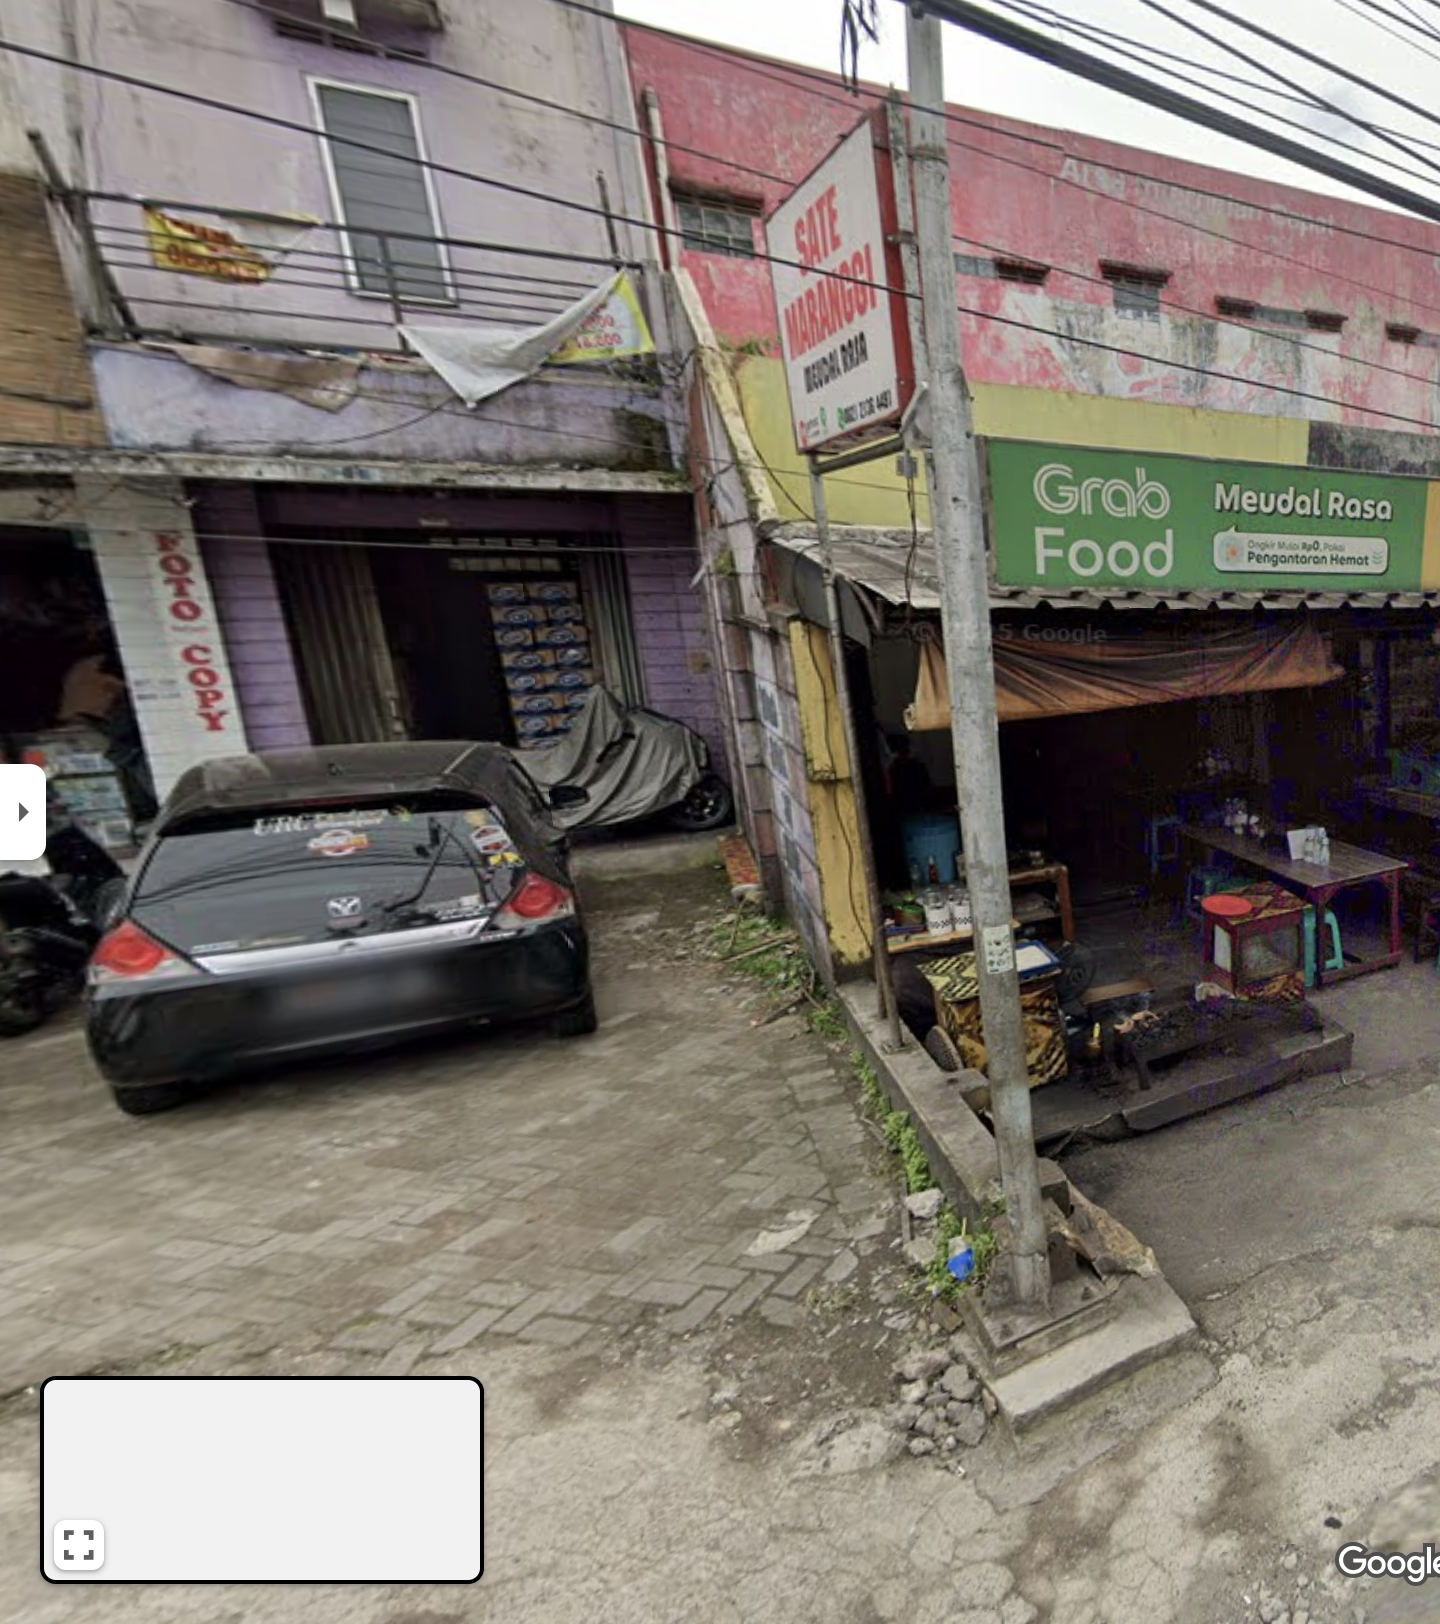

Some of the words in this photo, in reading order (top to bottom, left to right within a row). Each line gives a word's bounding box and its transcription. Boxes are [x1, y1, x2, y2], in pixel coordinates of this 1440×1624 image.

[795, 184, 842, 277] SATE
[784, 242, 877, 361] MARANGGI
[1033, 463, 1171, 520] Grab
[1214, 483, 1322, 516] Meudal
[1328, 491, 1393, 521] Rasa
[1035, 526, 1174, 577] Food
[1247, 539, 1276, 552] Ongkir
[1247, 552, 1328, 567] Pengantaran
[1330, 553, 1369, 566] Hemat
[155, 533, 202, 622] FOTO
[180, 644, 229, 732] COPY
